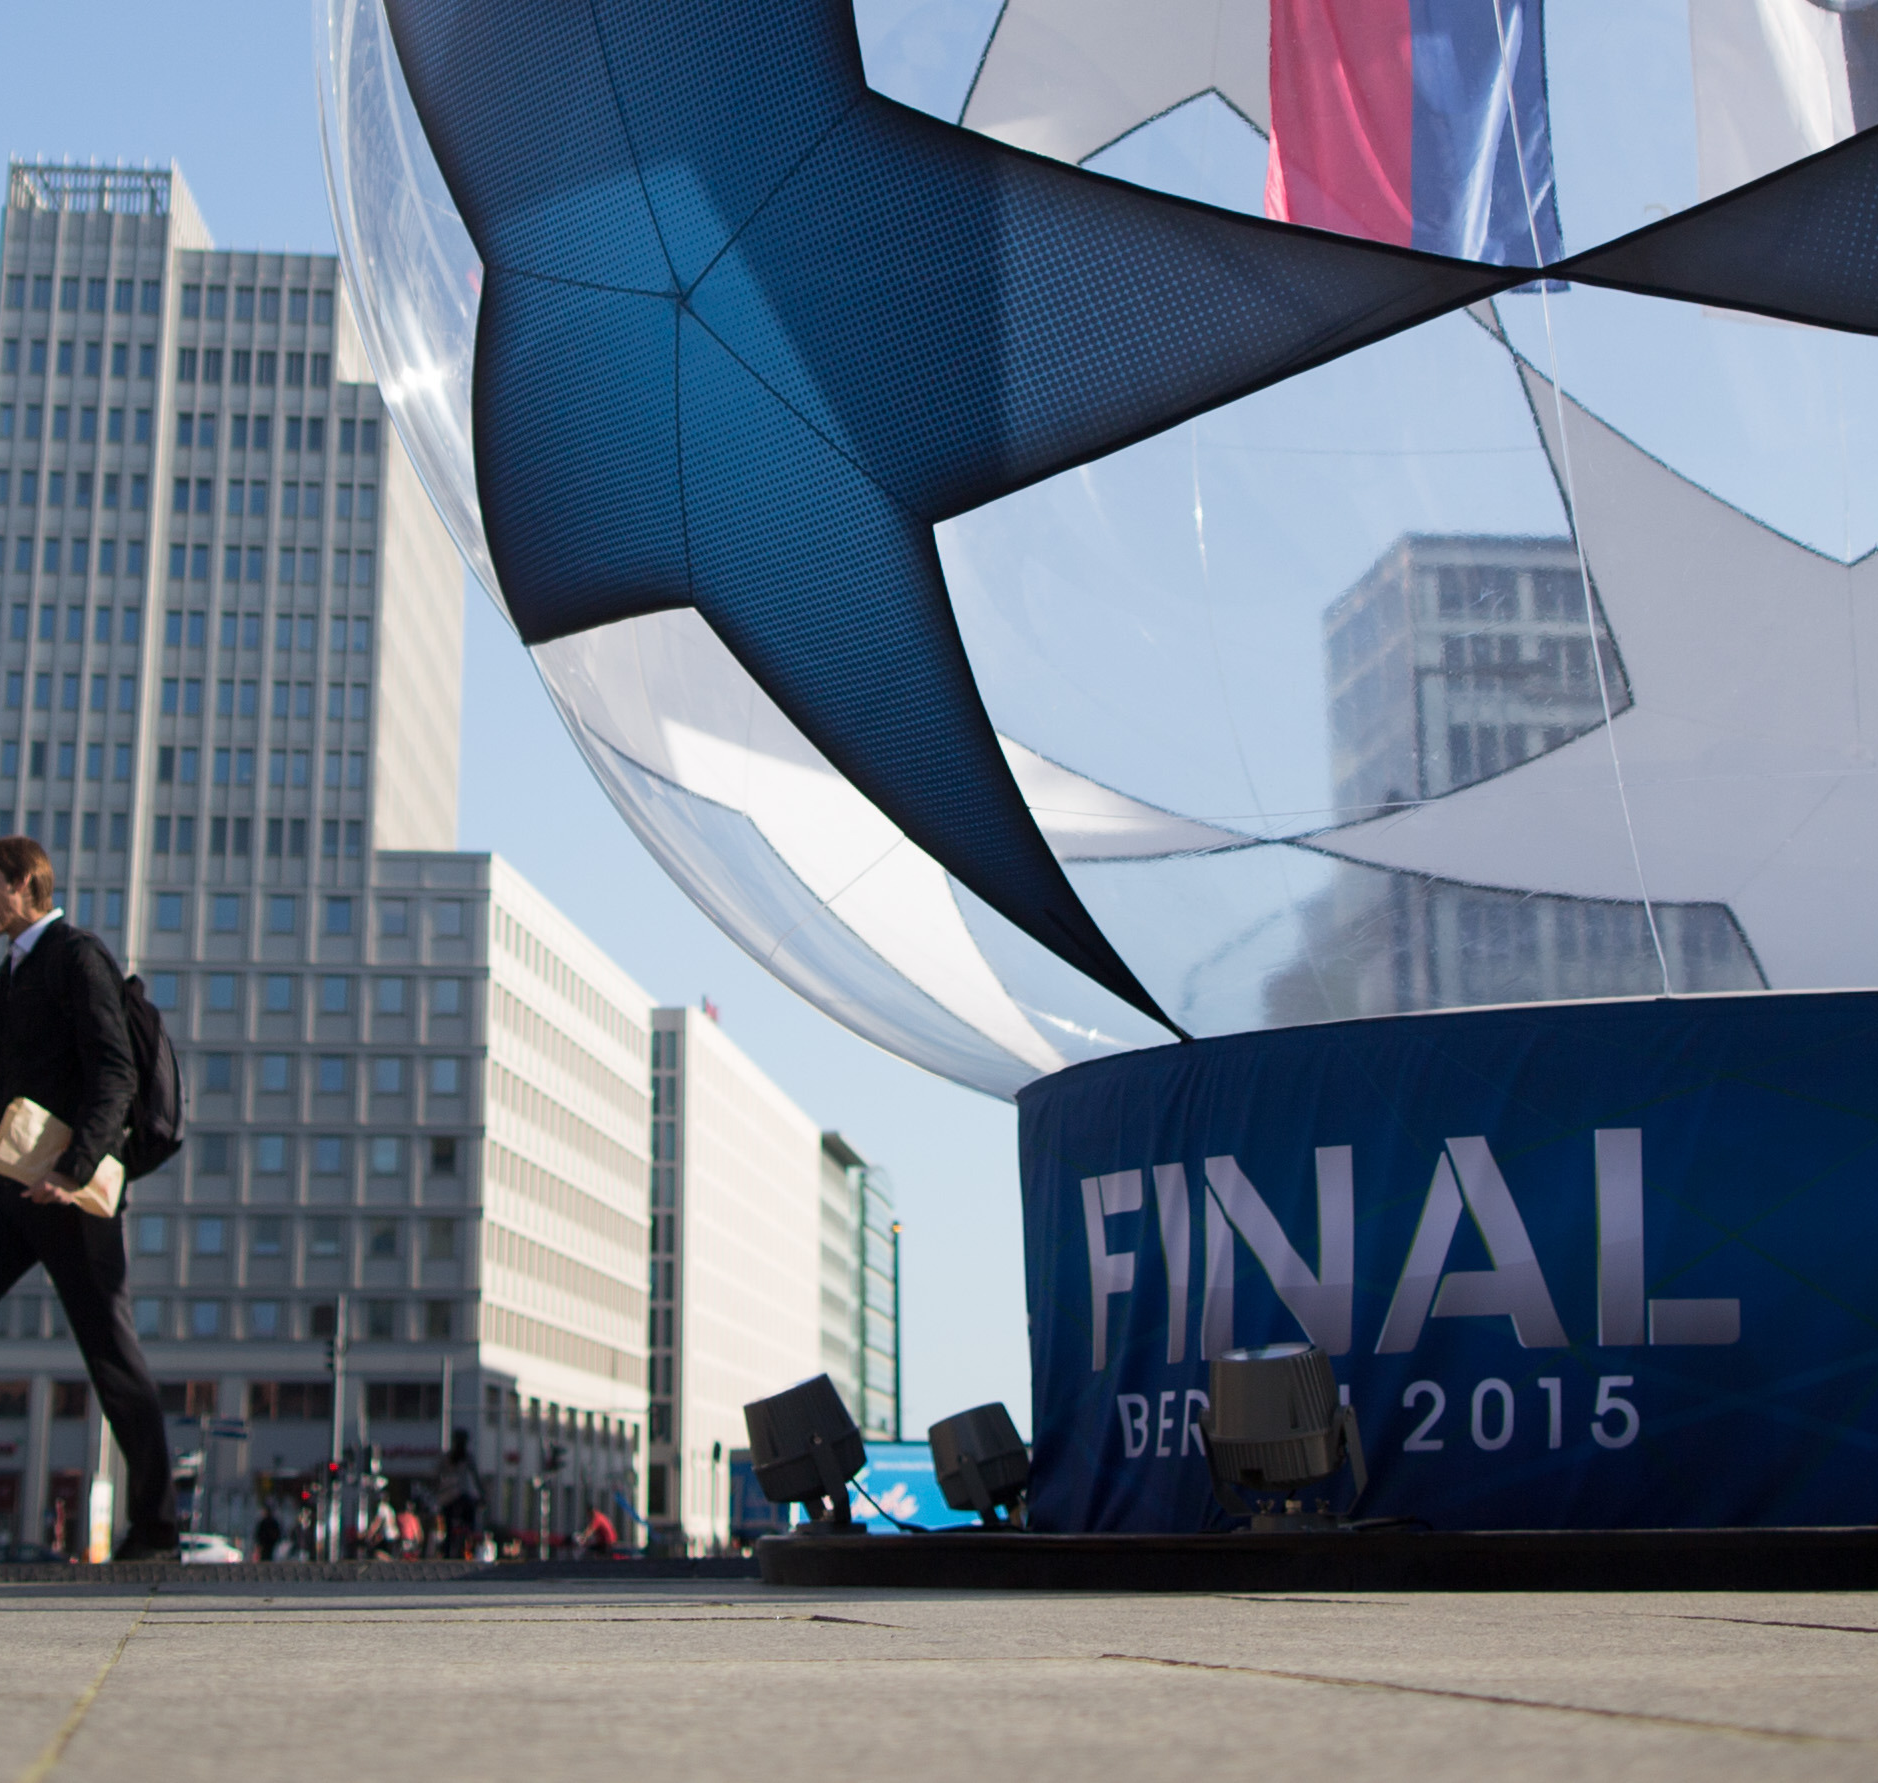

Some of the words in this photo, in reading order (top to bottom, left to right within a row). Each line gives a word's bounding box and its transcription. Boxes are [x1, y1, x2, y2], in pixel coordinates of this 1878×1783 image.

[1080, 1127, 1740, 1372] FINAL
[1116, 1383, 1351, 1459] BER
[1402, 1375, 1641, 1451] 2015
